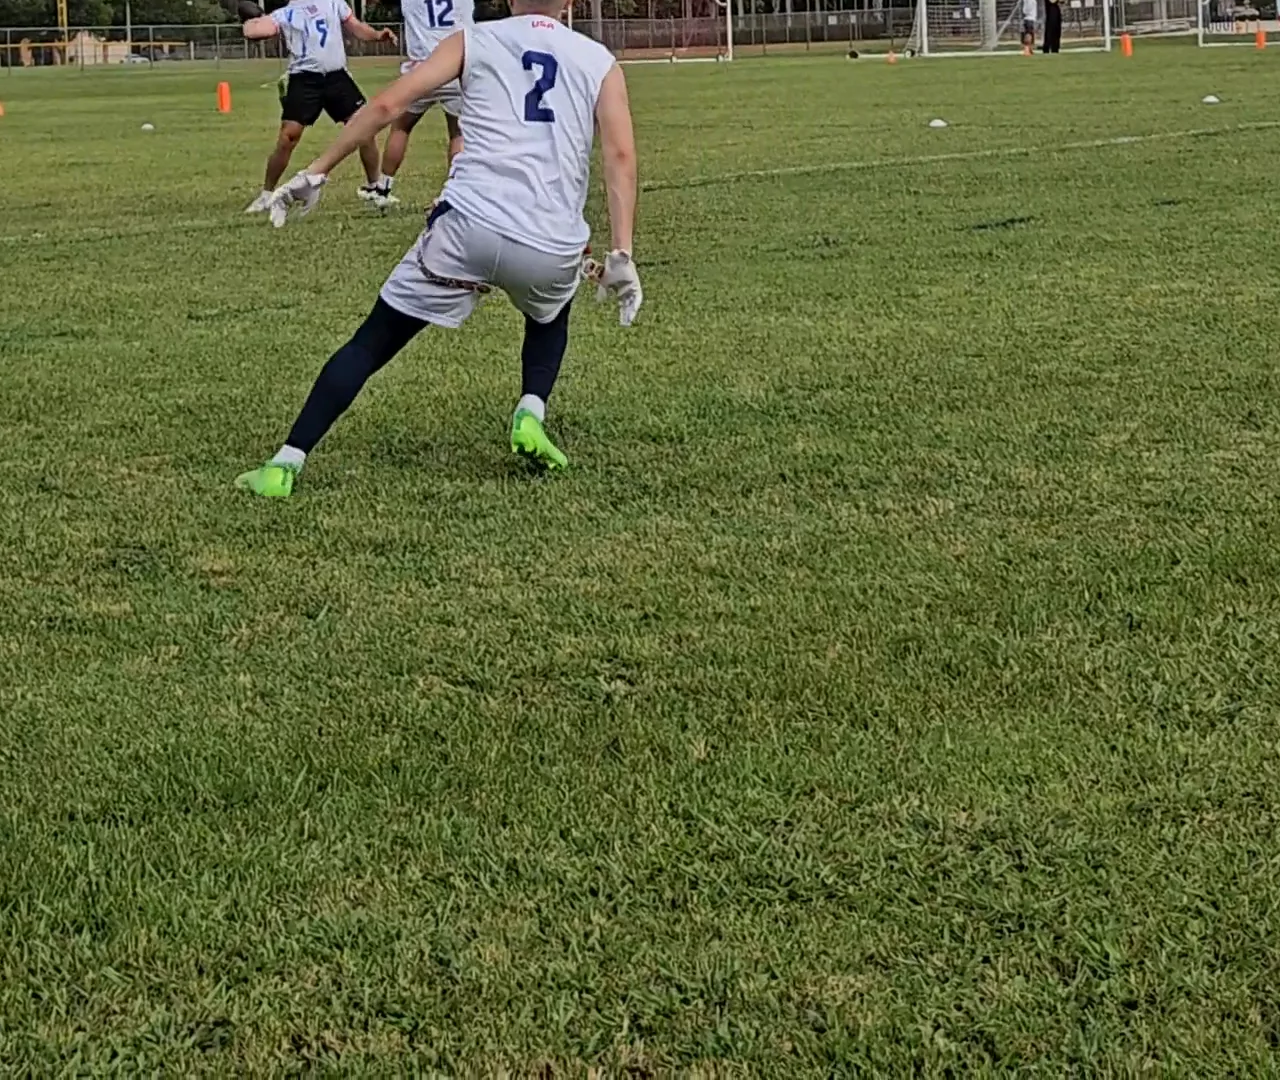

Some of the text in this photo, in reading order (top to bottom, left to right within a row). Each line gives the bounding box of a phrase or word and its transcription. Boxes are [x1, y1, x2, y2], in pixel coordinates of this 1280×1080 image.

[315, 19, 327, 48] 5
[531, 21, 555, 30] USA
[521, 50, 558, 122] 2
